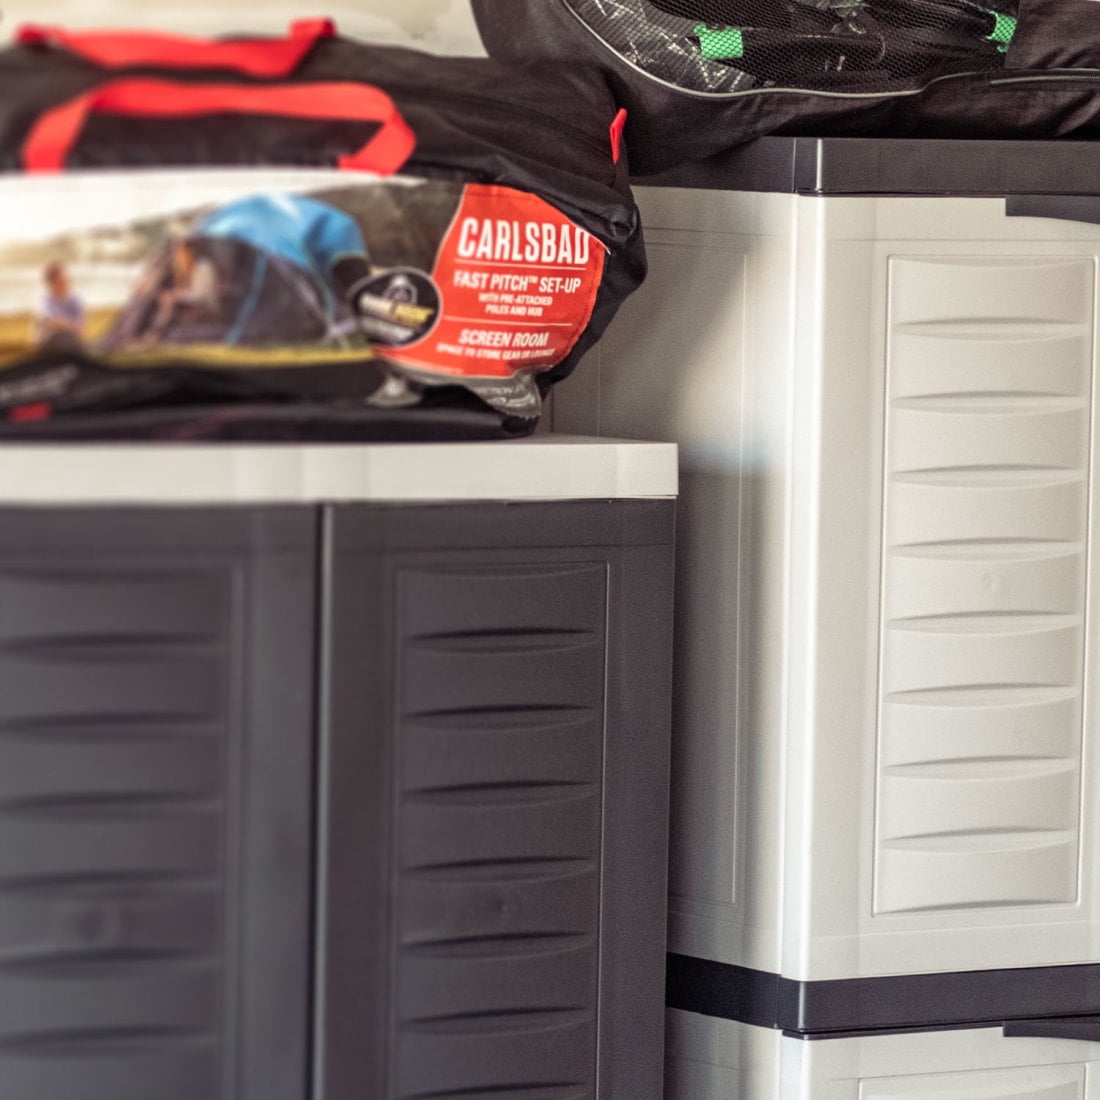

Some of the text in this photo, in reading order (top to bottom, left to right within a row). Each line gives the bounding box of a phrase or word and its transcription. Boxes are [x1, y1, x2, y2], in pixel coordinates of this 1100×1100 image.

[457, 217, 591, 265] CARLSBAD
[453, 270, 490, 290] FAST
[539, 277, 582, 294] SET-UP
[500, 293, 553, 306] PRE-ATTACHED
[485, 304, 543, 317] POLES AND HUB
[458, 329, 550, 347] SCREEN ROOM
[502, 348, 520, 360] GEAR
